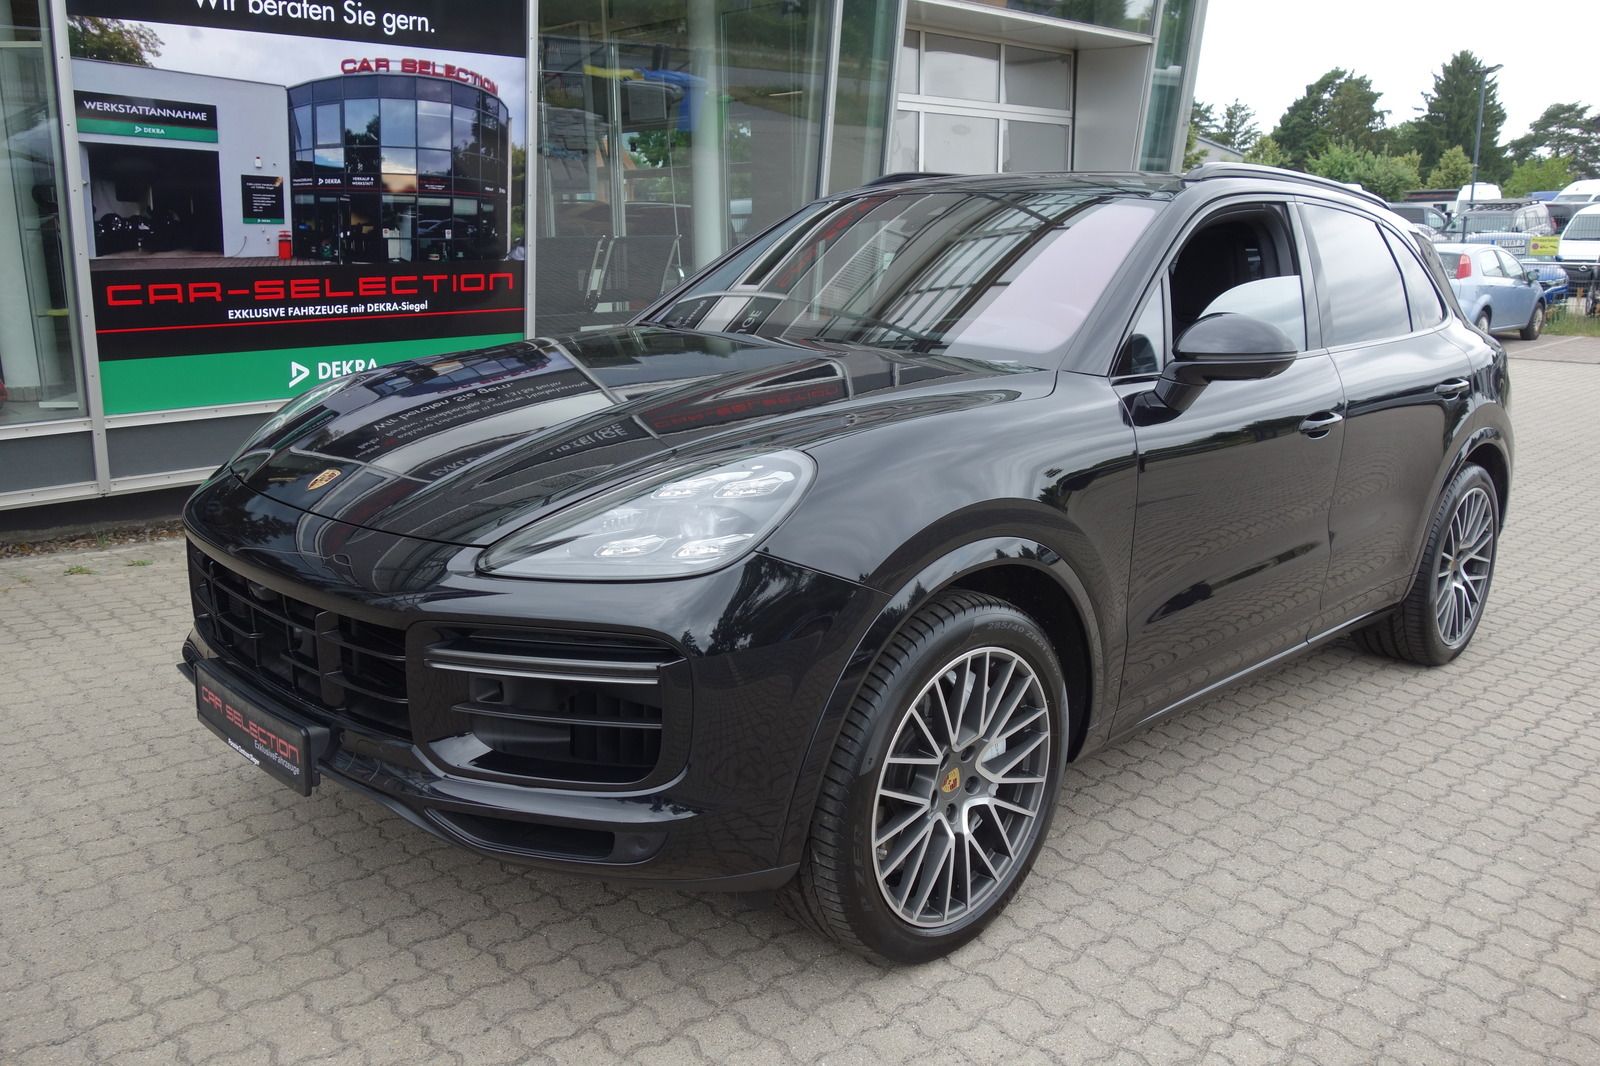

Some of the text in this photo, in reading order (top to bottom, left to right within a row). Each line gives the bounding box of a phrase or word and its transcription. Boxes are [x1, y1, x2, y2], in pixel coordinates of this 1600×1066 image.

[249, 0, 335, 22] beraten
[343, 0, 376, 26] Sie
[382, 11, 436, 35] gern.
[341, 58, 499, 95] CAR SELECTION
[83, 100, 208, 121] WERKSTATTANNAHME
[143, 127, 165, 135] DEKRA
[228, 300, 428, 319] EXKLUSIVE FAHRZEUGE mit DEKRA-Siegel
[318, 358, 378, 380] DEKRA
[202, 686, 223, 714] CAR
[225, 706, 300, 765] SELECTION
